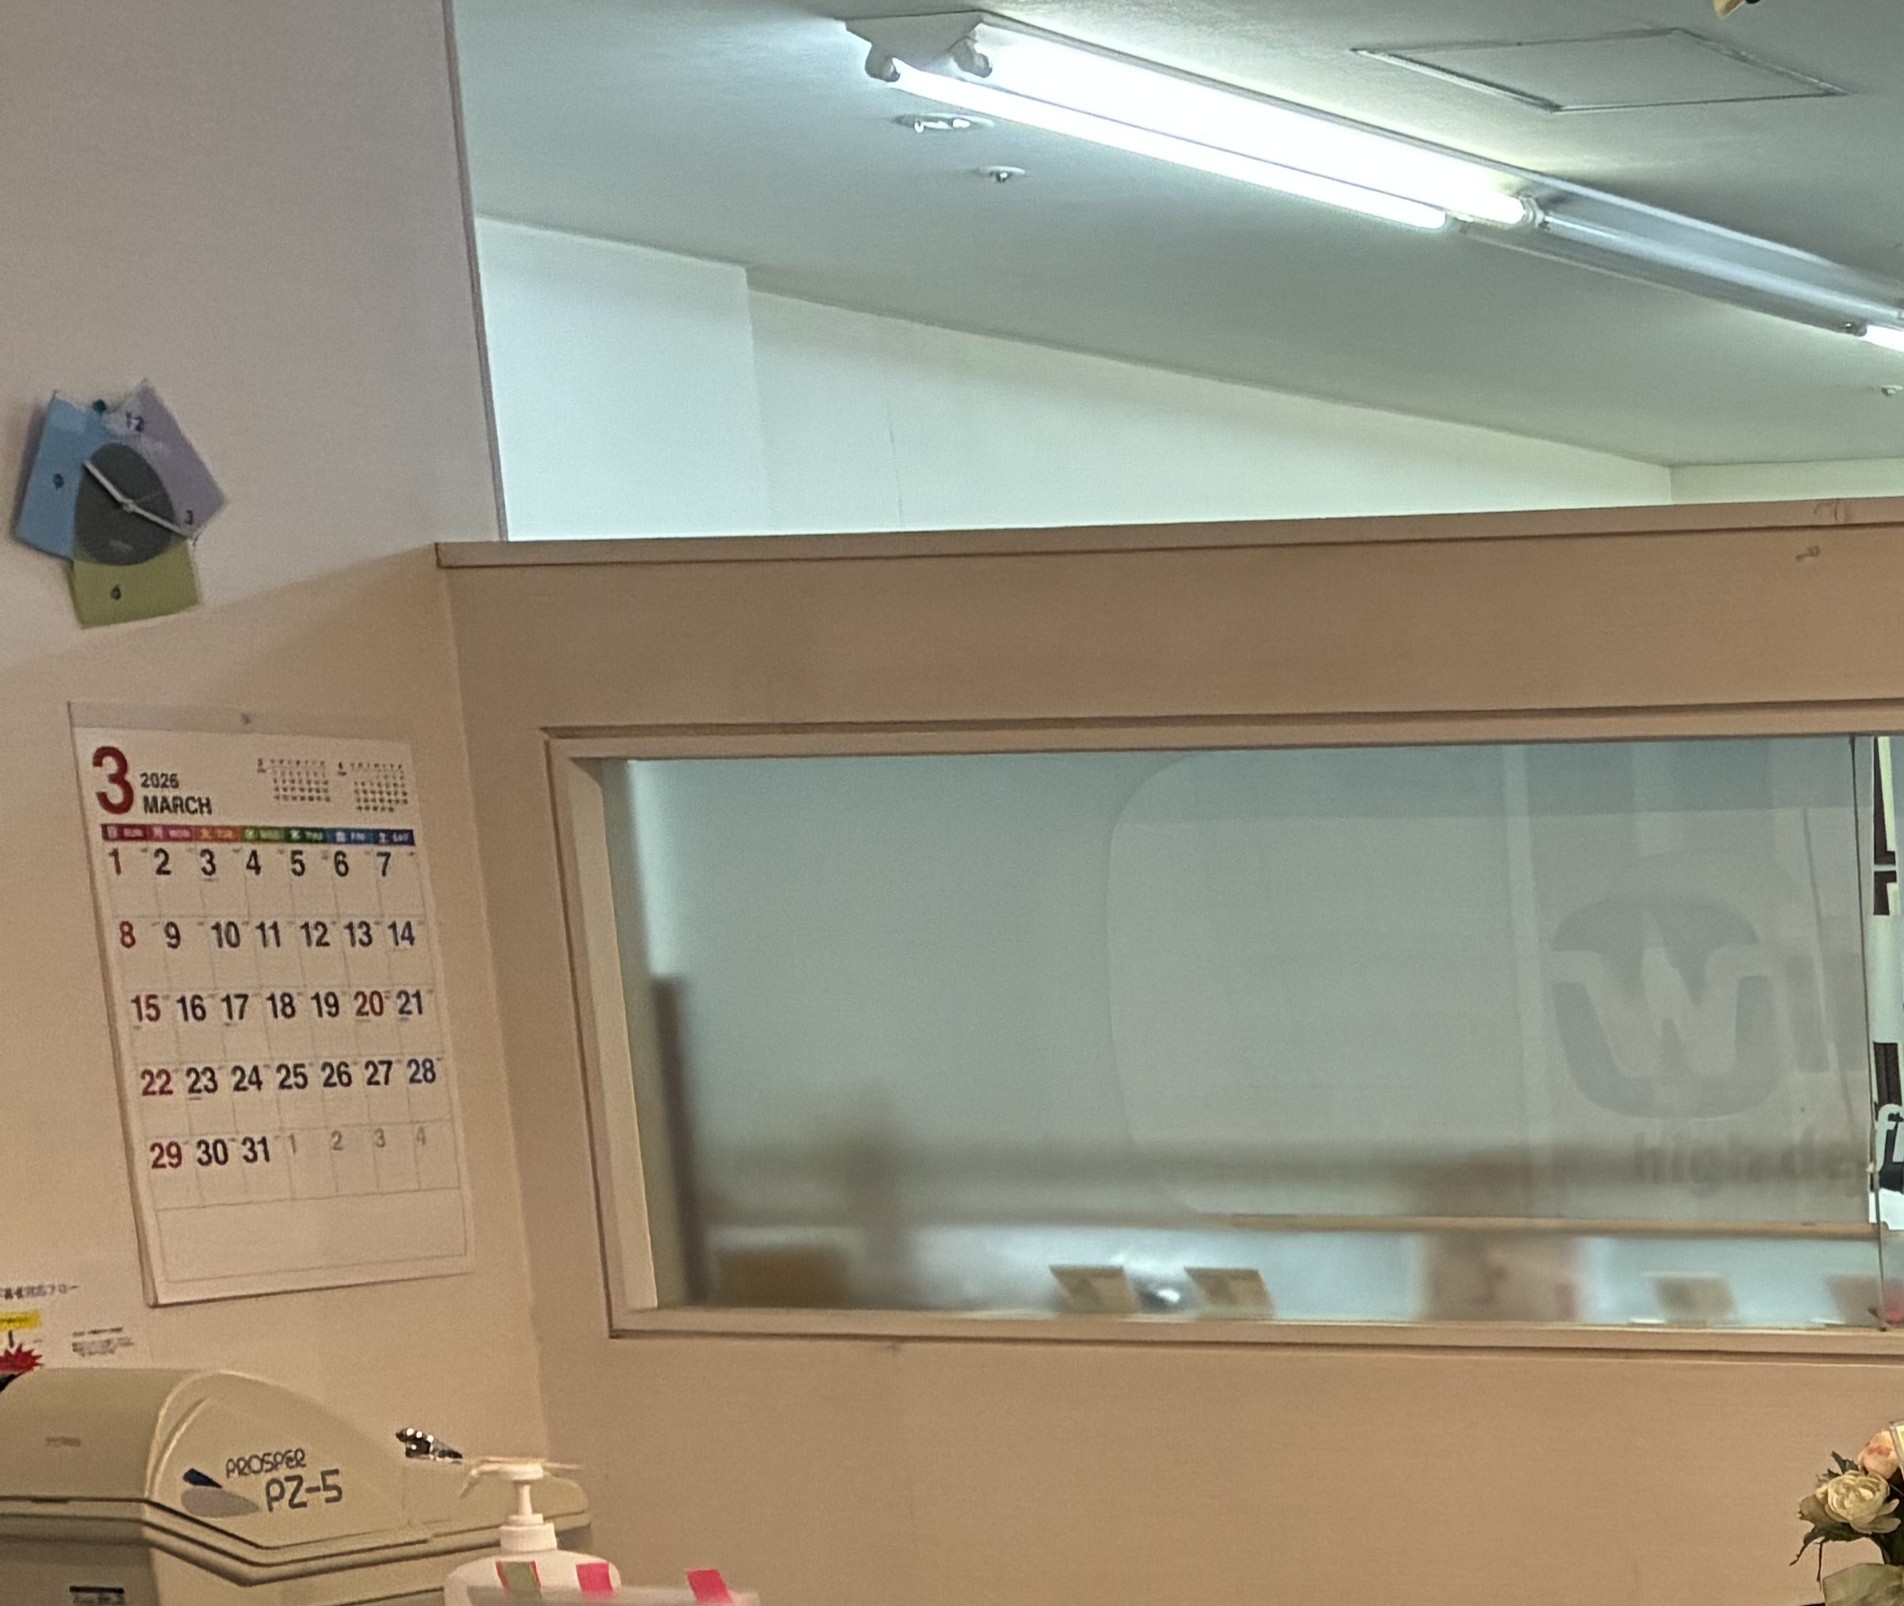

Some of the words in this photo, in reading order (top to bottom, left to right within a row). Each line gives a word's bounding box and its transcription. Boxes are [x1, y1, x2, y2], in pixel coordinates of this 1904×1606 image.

[126, 412, 145, 432] 12
[92, 745, 134, 815] 3
[140, 772, 180, 789] 2026
[143, 795, 212, 814] MARCH
[109, 848, 121, 875] 1
[154, 848, 171, 875] 2
[200, 849, 216, 876] 3
[246, 850, 261, 875] 4
[290, 850, 305, 876] 5
[334, 851, 349, 877] 6
[377, 852, 391, 877] 7
[120, 921, 136, 948] 8
[164, 922, 181, 949] 9
[211, 921, 240, 948] 10
[255, 921, 280, 947] 11
[300, 921, 330, 947] 12
[344, 921, 373, 947] 13
[388, 920, 415, 946] 14
[132, 994, 161, 1021] 15
[176, 994, 206, 1021] 16
[221, 993, 249, 1020] 17
[266, 992, 296, 1019] 18
[312, 991, 339, 1017] 19
[355, 990, 384, 1016] 20
[396, 989, 423, 1015] 21
[141, 1069, 174, 1096] 22
[186, 1067, 218, 1094] 23
[231, 1065, 263, 1091] 24
[276, 1063, 308, 1089] 25
[321, 1061, 352, 1087] 26
[364, 1060, 393, 1085] 27
[407, 1058, 436, 1084] 28
[150, 1141, 182, 1169] 29
[196, 1139, 228, 1166] 30
[241, 1136, 270, 1164] 31
[225, 1447, 307, 1479] PROSPER
[265, 1469, 343, 1513] PZ-5
